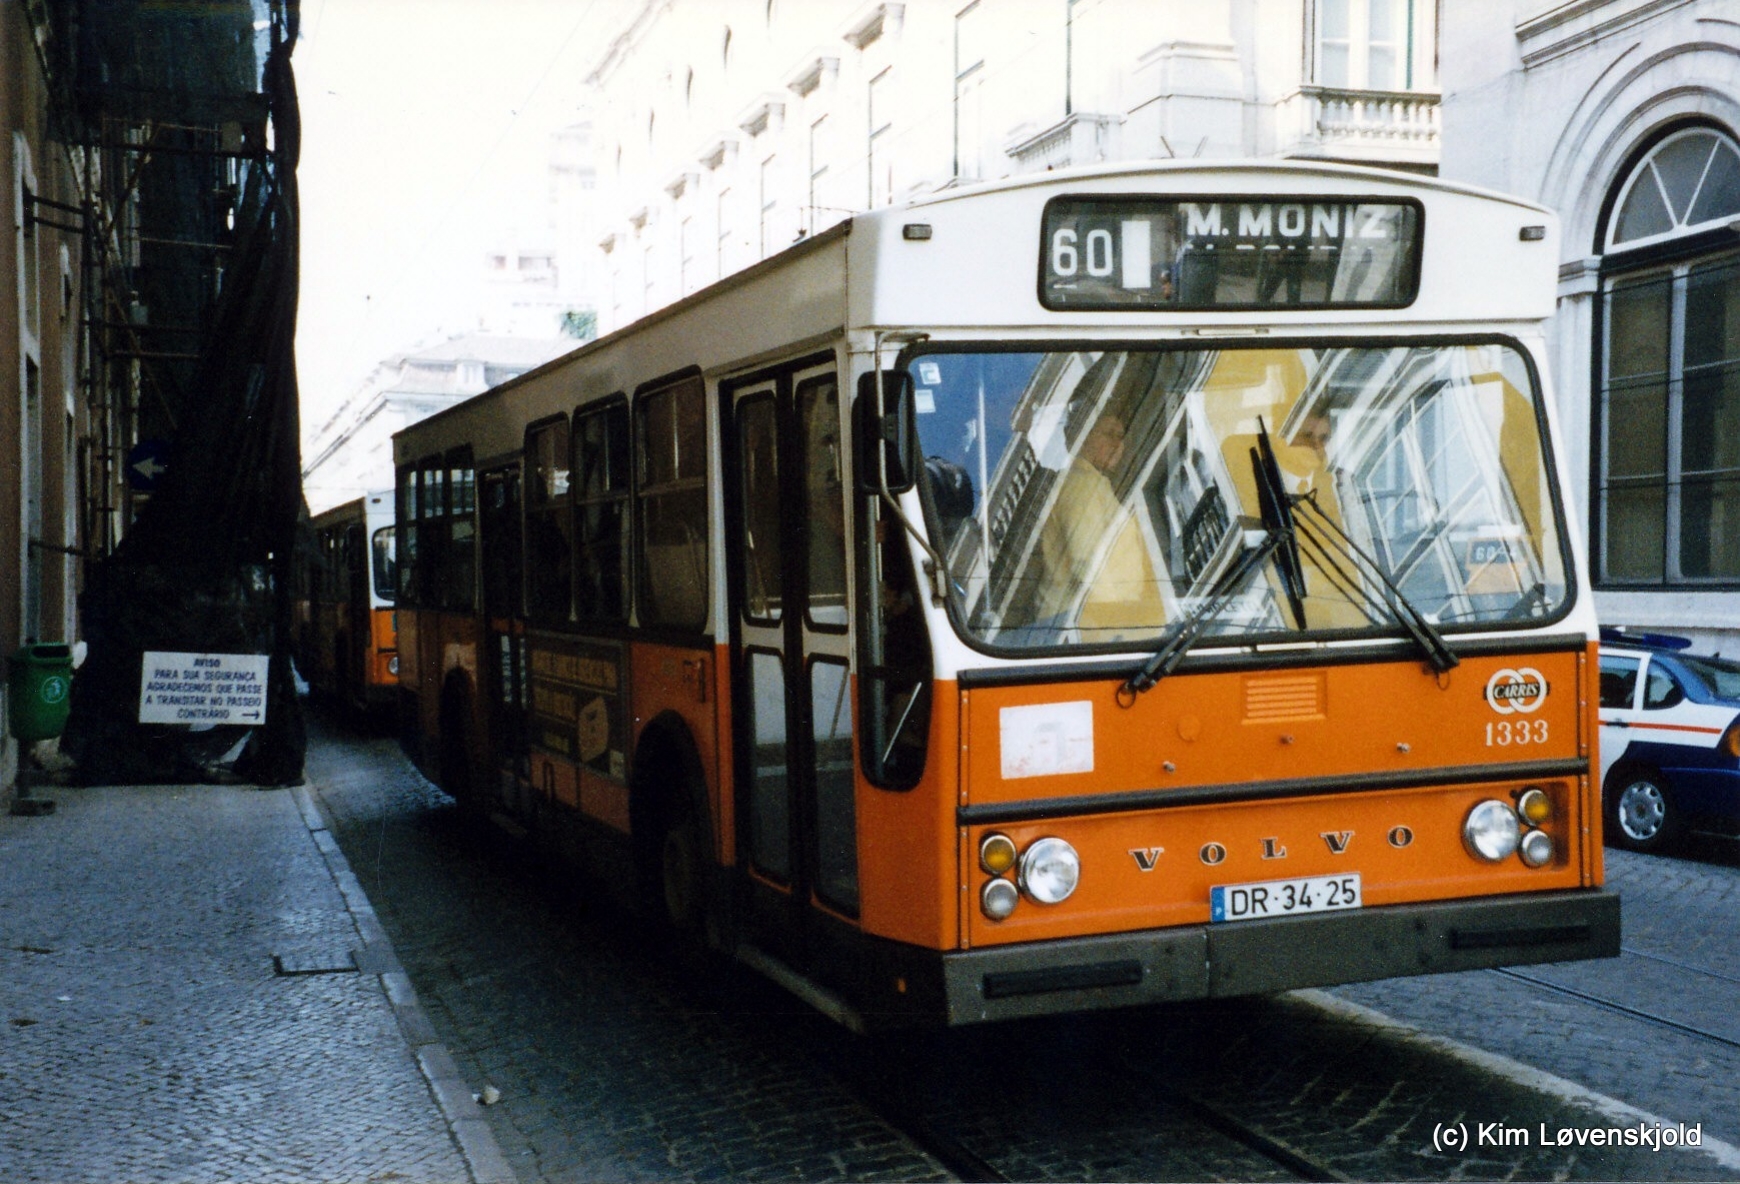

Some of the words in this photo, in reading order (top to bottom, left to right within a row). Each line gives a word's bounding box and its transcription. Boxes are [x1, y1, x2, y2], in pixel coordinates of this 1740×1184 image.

[1186, 203, 1229, 236] M.
[1238, 204, 1387, 239] MONIZ
[1052, 228, 1113, 277] 60
[193, 658, 221, 667] AVISO
[154, 669, 178, 679] PARA
[183, 670, 199, 680] SUA
[146, 682, 212, 693] AGRADECEMOS
[216, 685, 232, 694] QUE
[236, 684, 262, 694] PASSE
[1494, 683, 1539, 699] CARRIS
[145, 695, 152, 704] A
[157, 695, 206, 705] TRANSITAR
[210, 697, 222, 706] NO
[227, 697, 261, 707] PASSEIO
[1486, 720, 1549, 747] 1333
[1128, 825, 1414, 872] VOLVO
